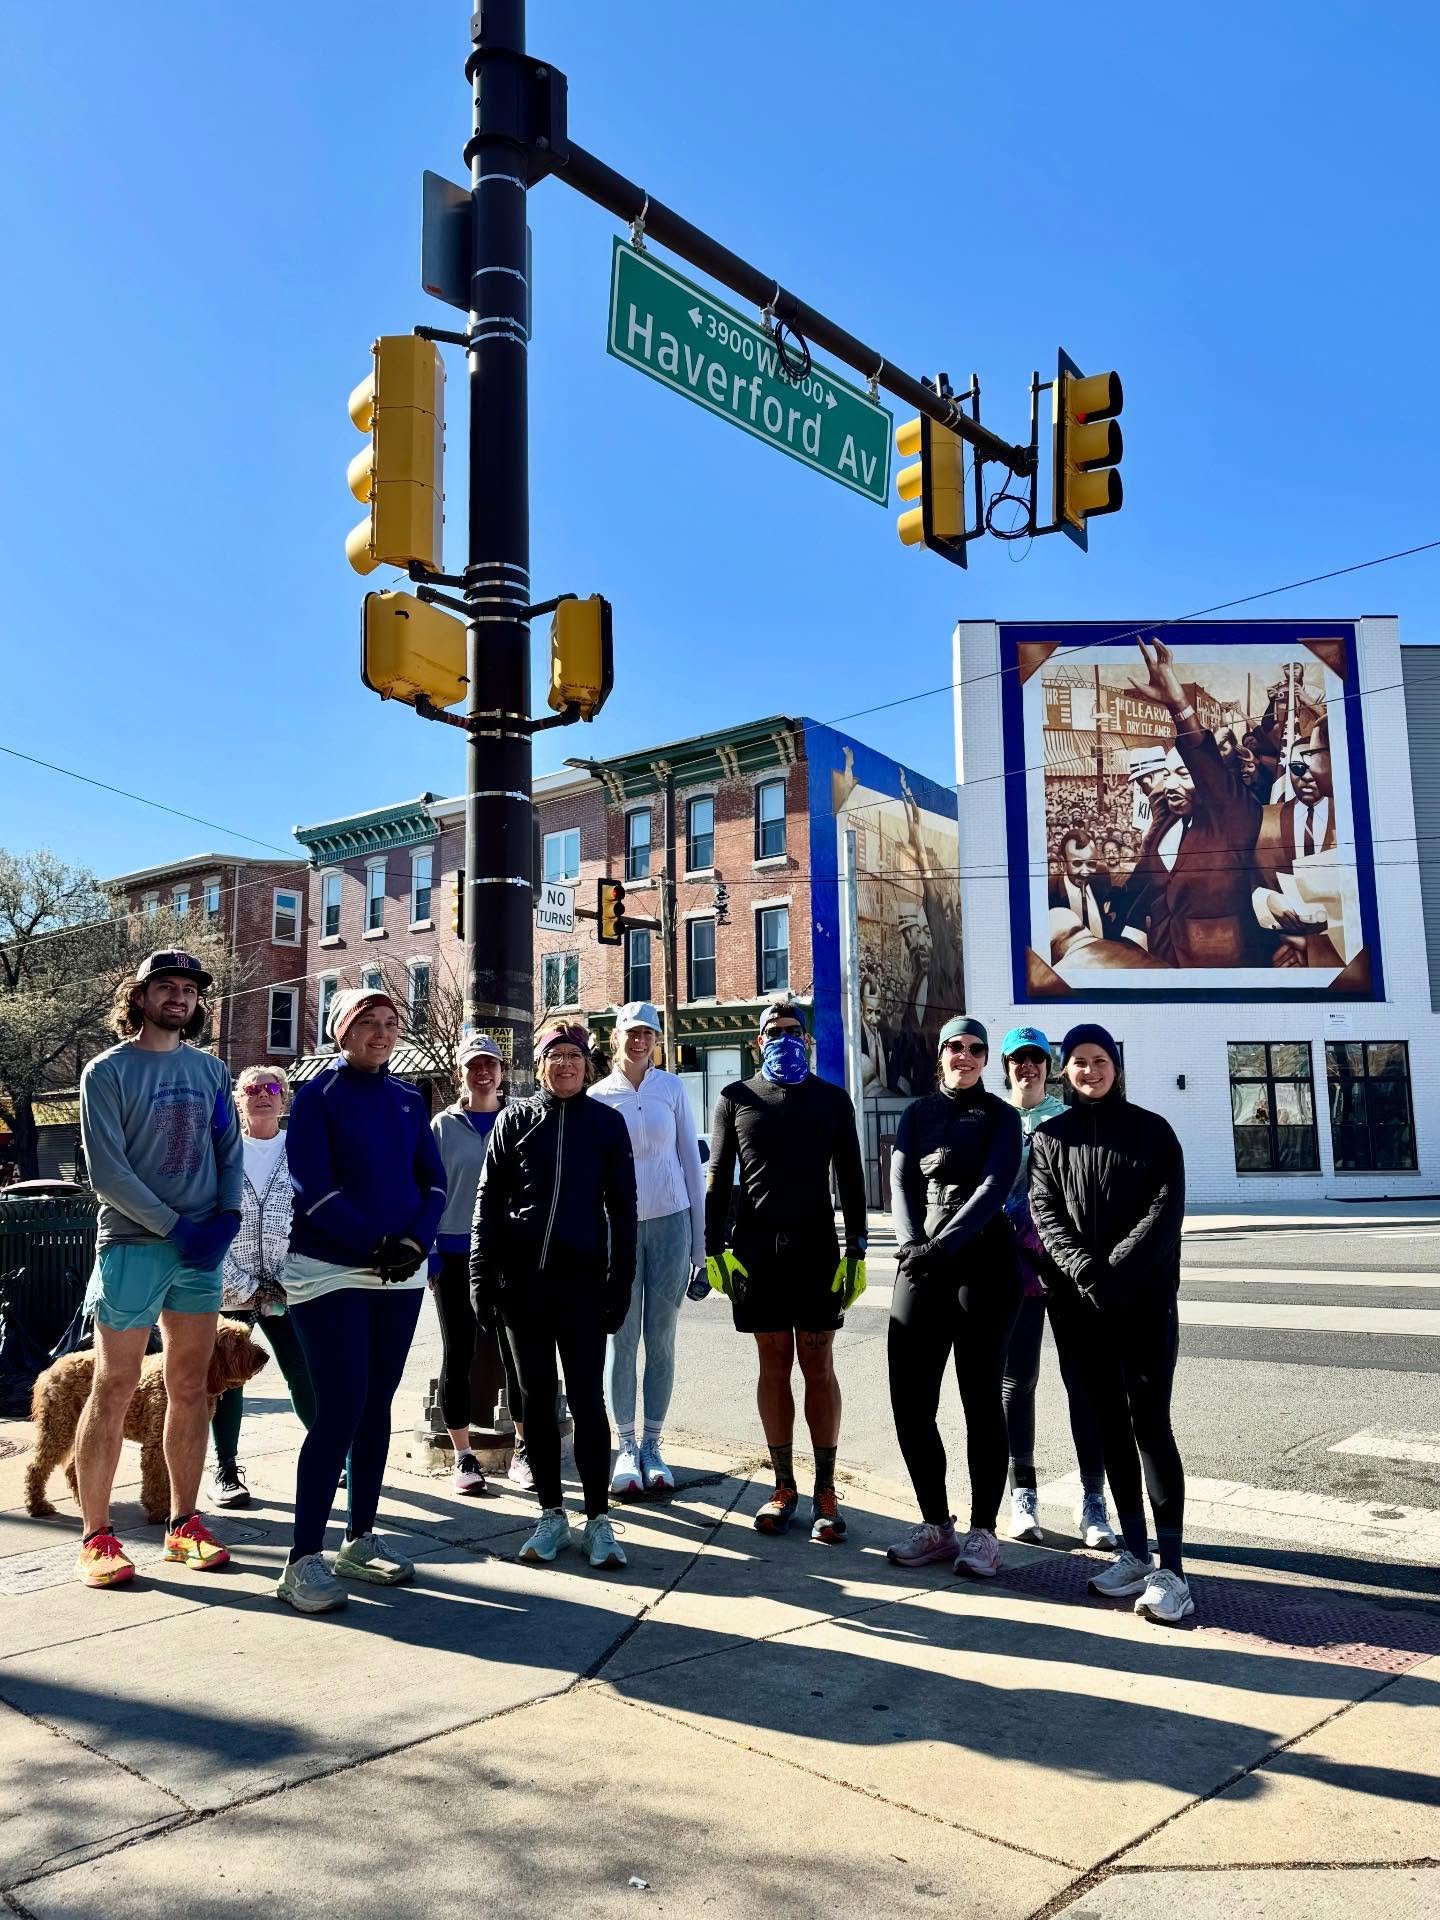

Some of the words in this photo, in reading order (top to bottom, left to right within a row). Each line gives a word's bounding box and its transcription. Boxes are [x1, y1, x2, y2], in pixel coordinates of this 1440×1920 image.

[706, 314, 754, 361] 3900
[756, 341, 779, 378] W
[627, 303, 822, 457] Haverford
[837, 434, 877, 485] Av
[1127, 720, 1140, 734] DRY
[547, 890, 566, 907] NO
[539, 910, 573, 926] TURNS
